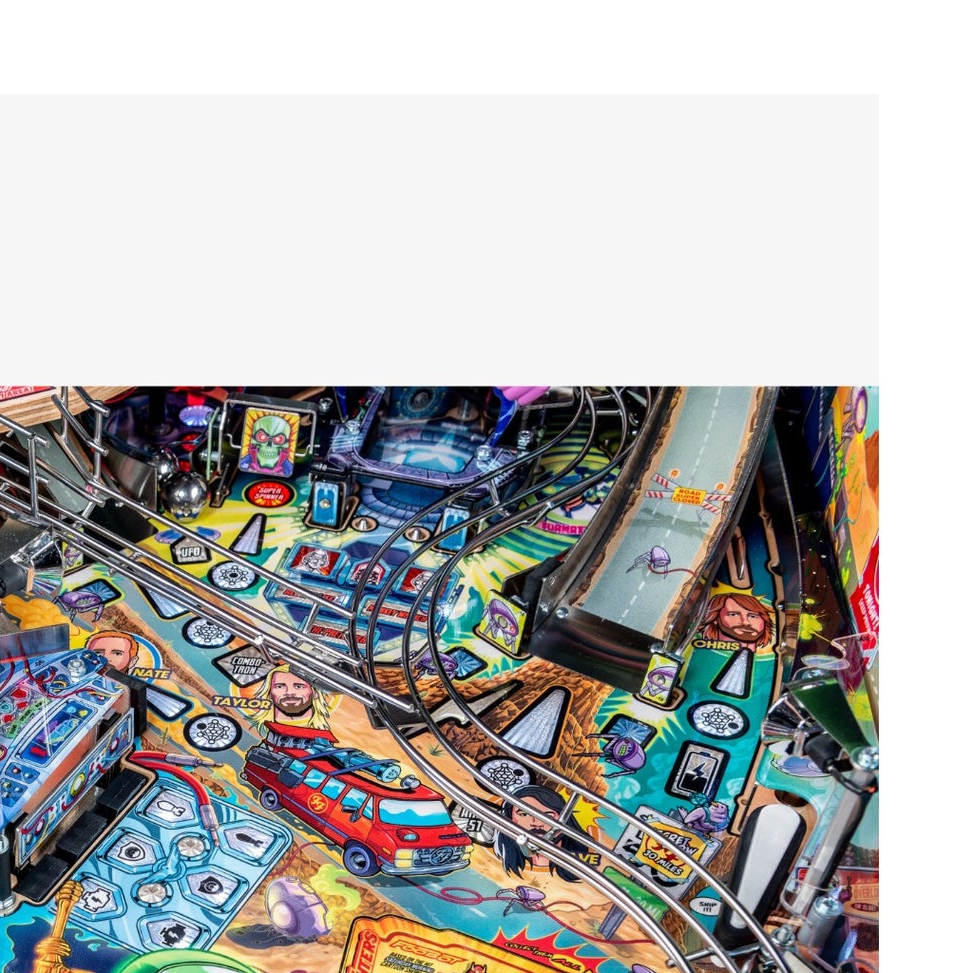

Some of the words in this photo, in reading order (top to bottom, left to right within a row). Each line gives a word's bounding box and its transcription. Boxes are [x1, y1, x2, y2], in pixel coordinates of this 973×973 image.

[254, 493, 284, 501] SPINNER
[678, 488, 702, 496] ROAD
[673, 497, 701, 505] CLOSED
[180, 546, 202, 558] UFO
[693, 639, 741, 652] CHRIS
[132, 666, 171, 681] NATE
[232, 665, 258, 675] TRON
[212, 695, 273, 711] TAYLOR
[656, 859, 684, 876] MILES
[505, 942, 540, 952] COLLECT
